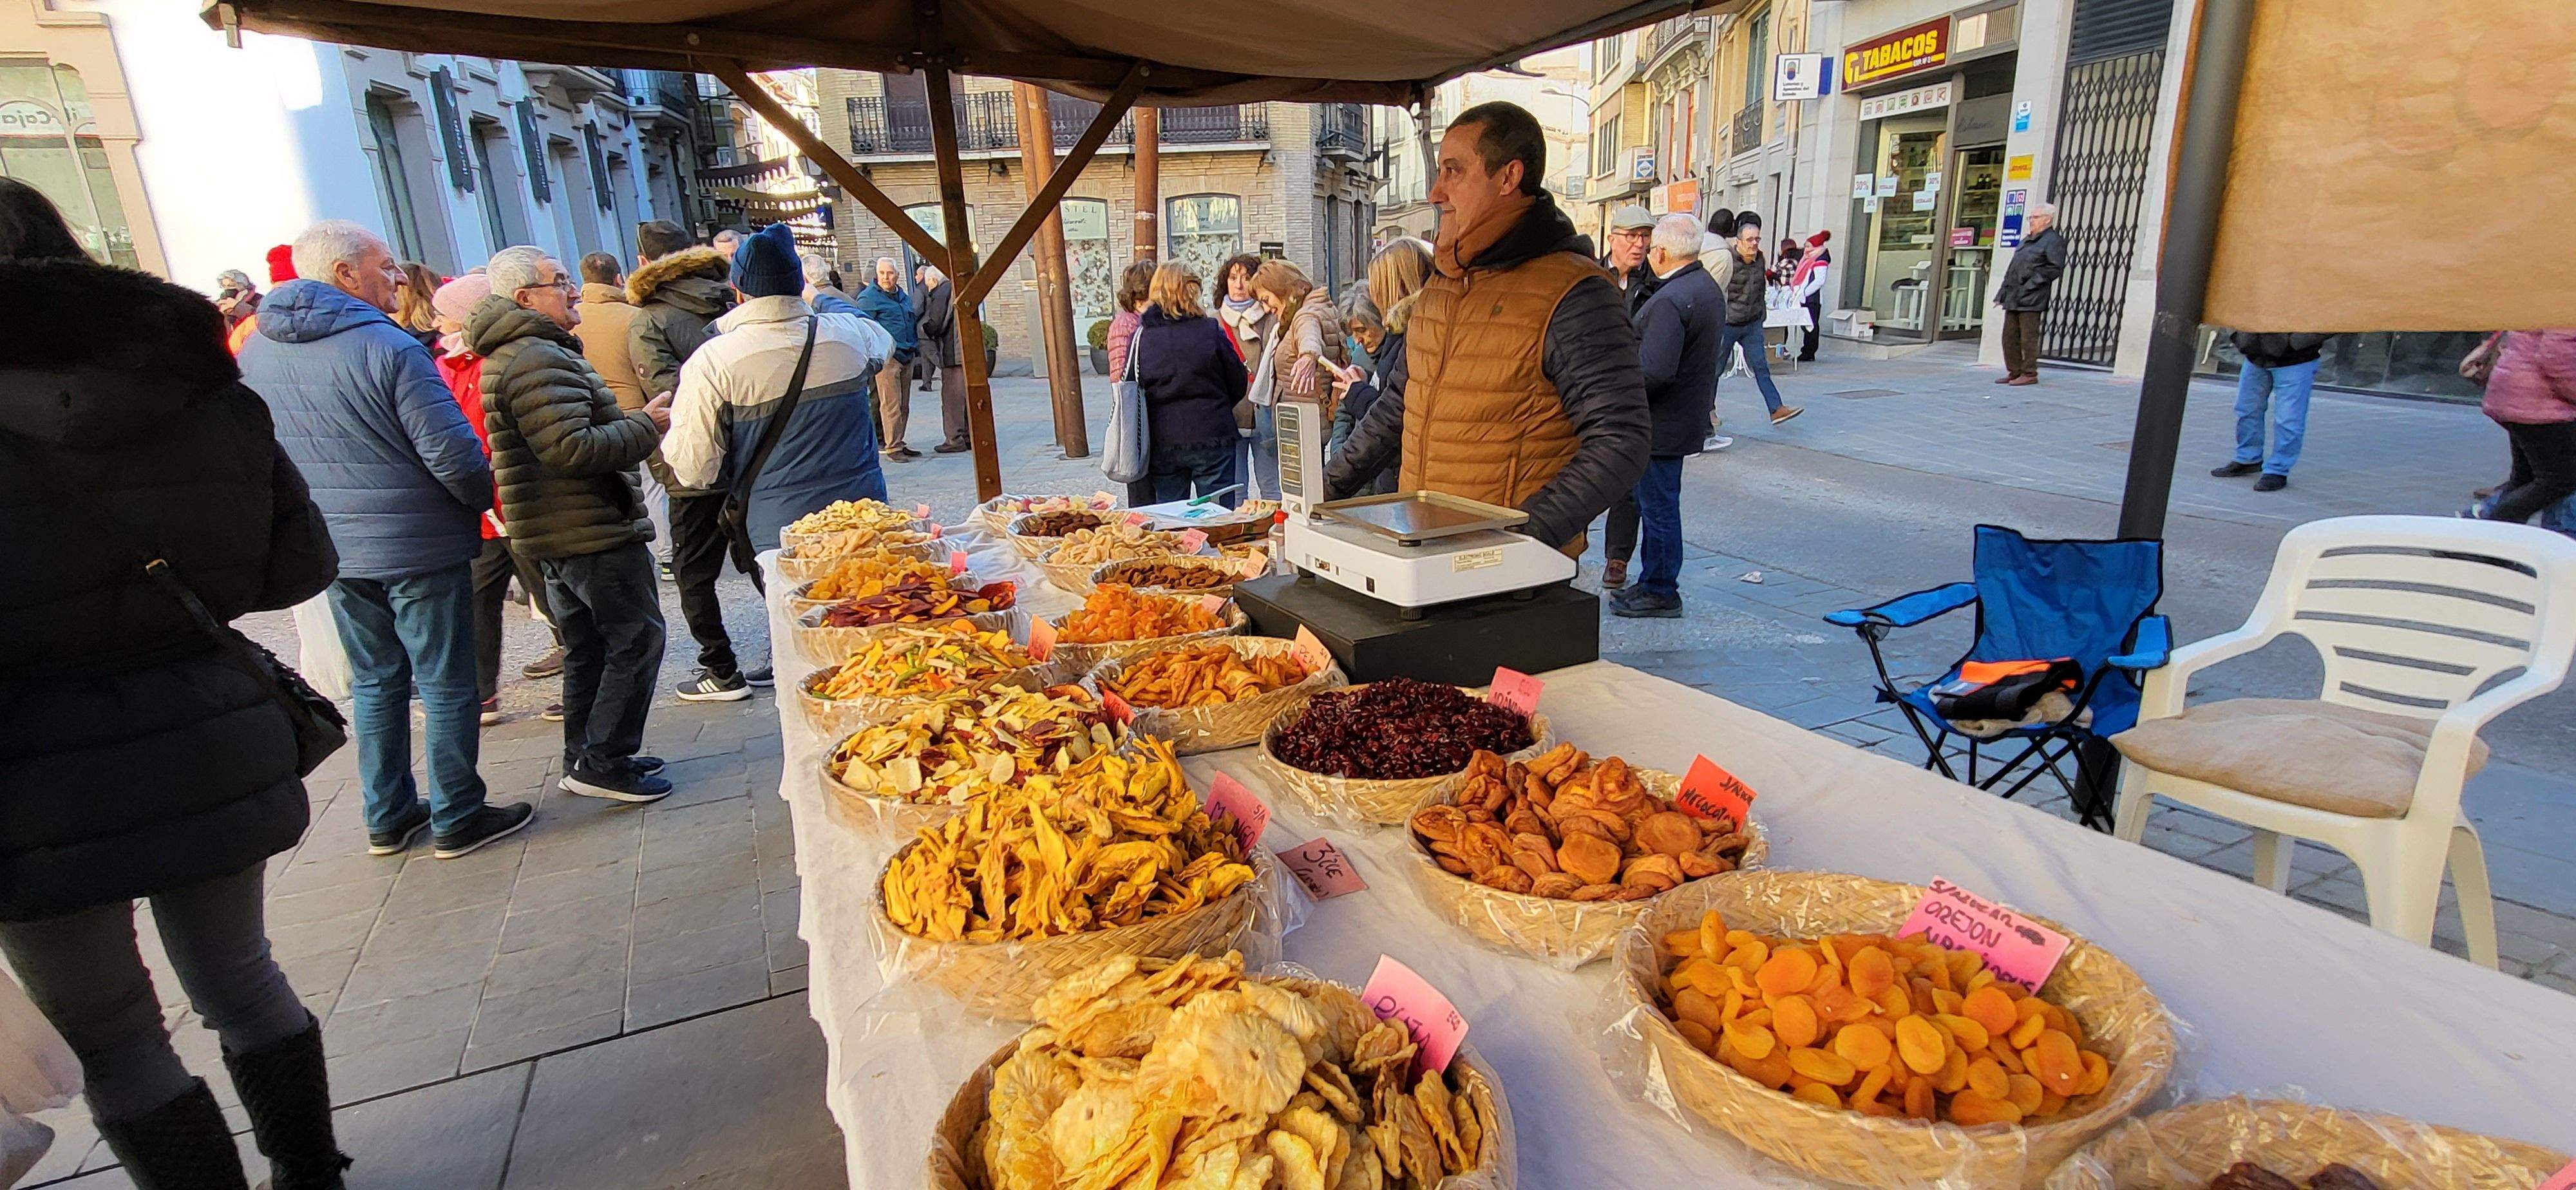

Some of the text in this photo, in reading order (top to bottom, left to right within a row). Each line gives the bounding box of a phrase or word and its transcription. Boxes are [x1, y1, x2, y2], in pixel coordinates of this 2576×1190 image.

[1862, 30, 1938, 71] TABACOS
[1855, 180, 1868, 191] 30%
[1064, 205, 1097, 214] STEL
[1299, 644, 1318, 665] PER
[1253, 804, 1266, 824] S/A
[1209, 801, 1255, 850] MNGO
[1924, 901, 2002, 949] OREJON
